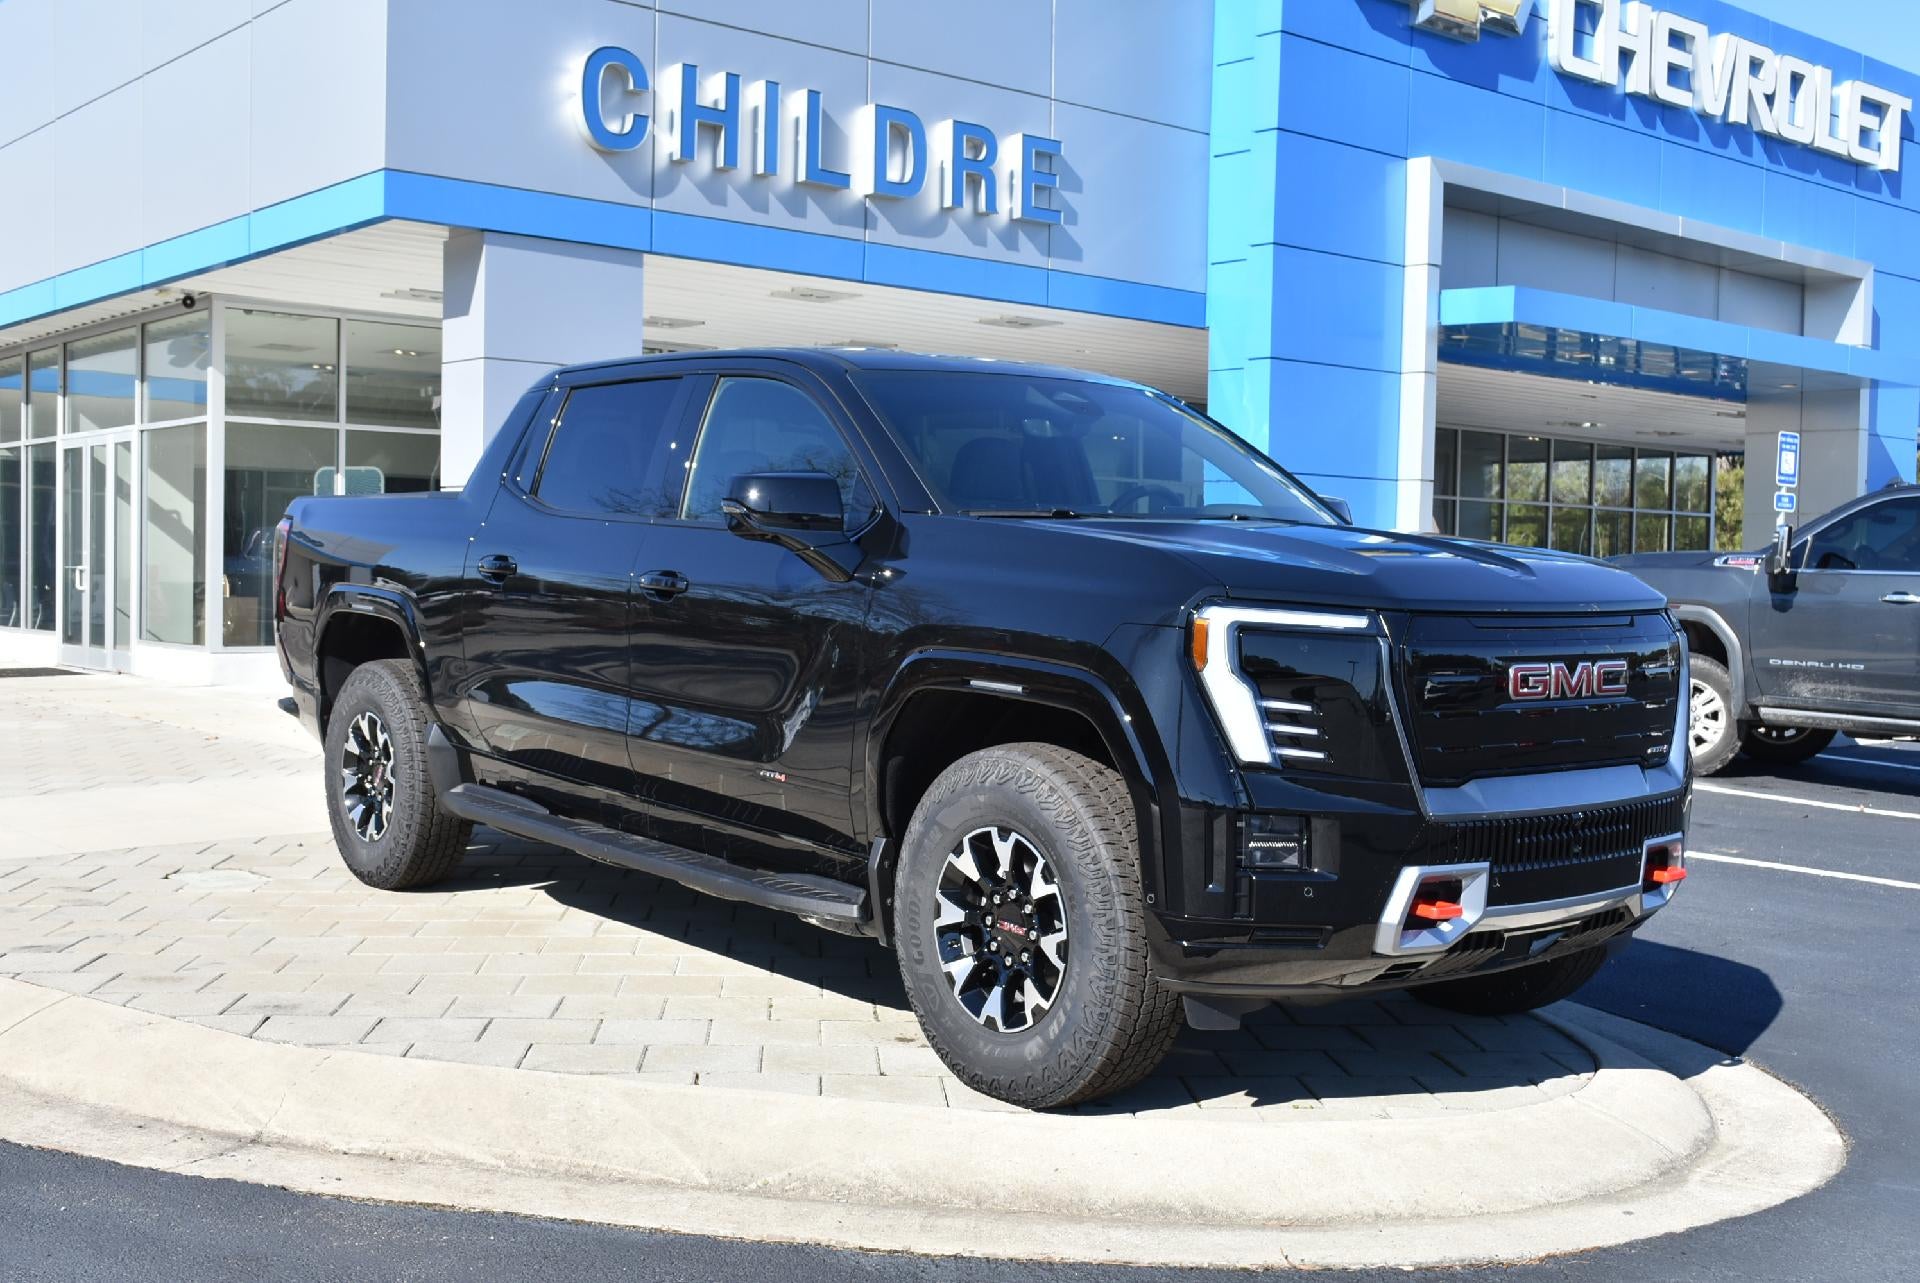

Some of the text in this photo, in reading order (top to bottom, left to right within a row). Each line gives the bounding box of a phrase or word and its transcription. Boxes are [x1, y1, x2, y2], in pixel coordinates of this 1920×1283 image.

[577, 45, 1063, 225] CHILDRE
[1547, 0, 1912, 172] CHEVROLET
[1508, 660, 1627, 700] GMC
[1769, 658, 1834, 668] DENALI
